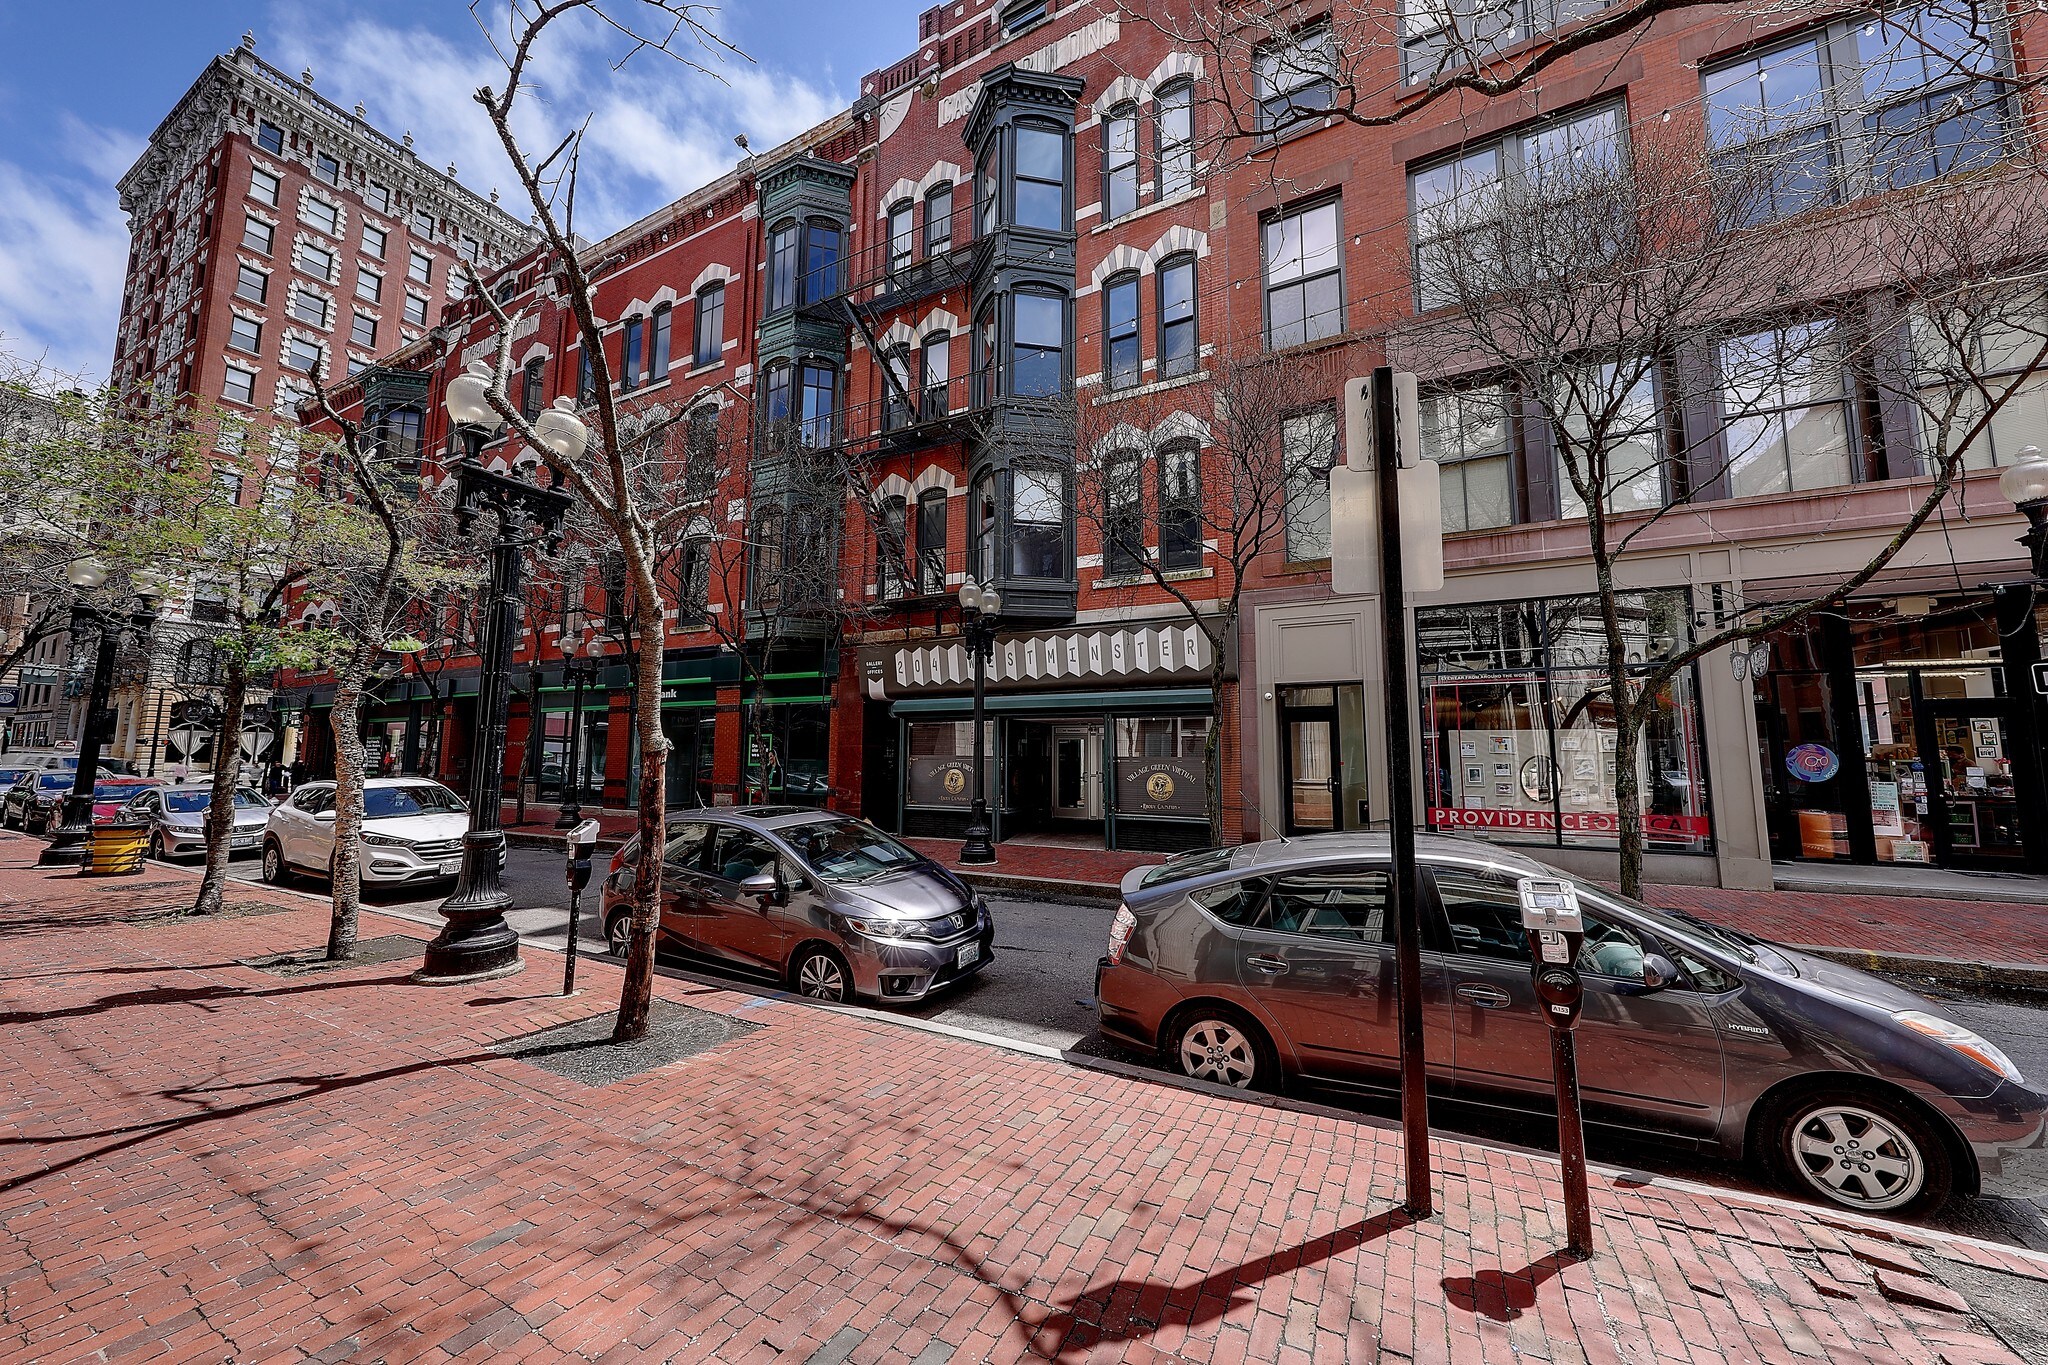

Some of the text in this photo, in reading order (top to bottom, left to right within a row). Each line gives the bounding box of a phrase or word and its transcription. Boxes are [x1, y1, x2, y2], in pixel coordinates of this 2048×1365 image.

[897, 657, 938, 674] 204
[661, 688, 678, 699] ank
[1126, 763, 1197, 785] VILLAGE GREEN VIRTUAL
[1435, 809, 1697, 833] PROVIDENCE OICAL
[1727, 1023, 1765, 1034] HYBRID
